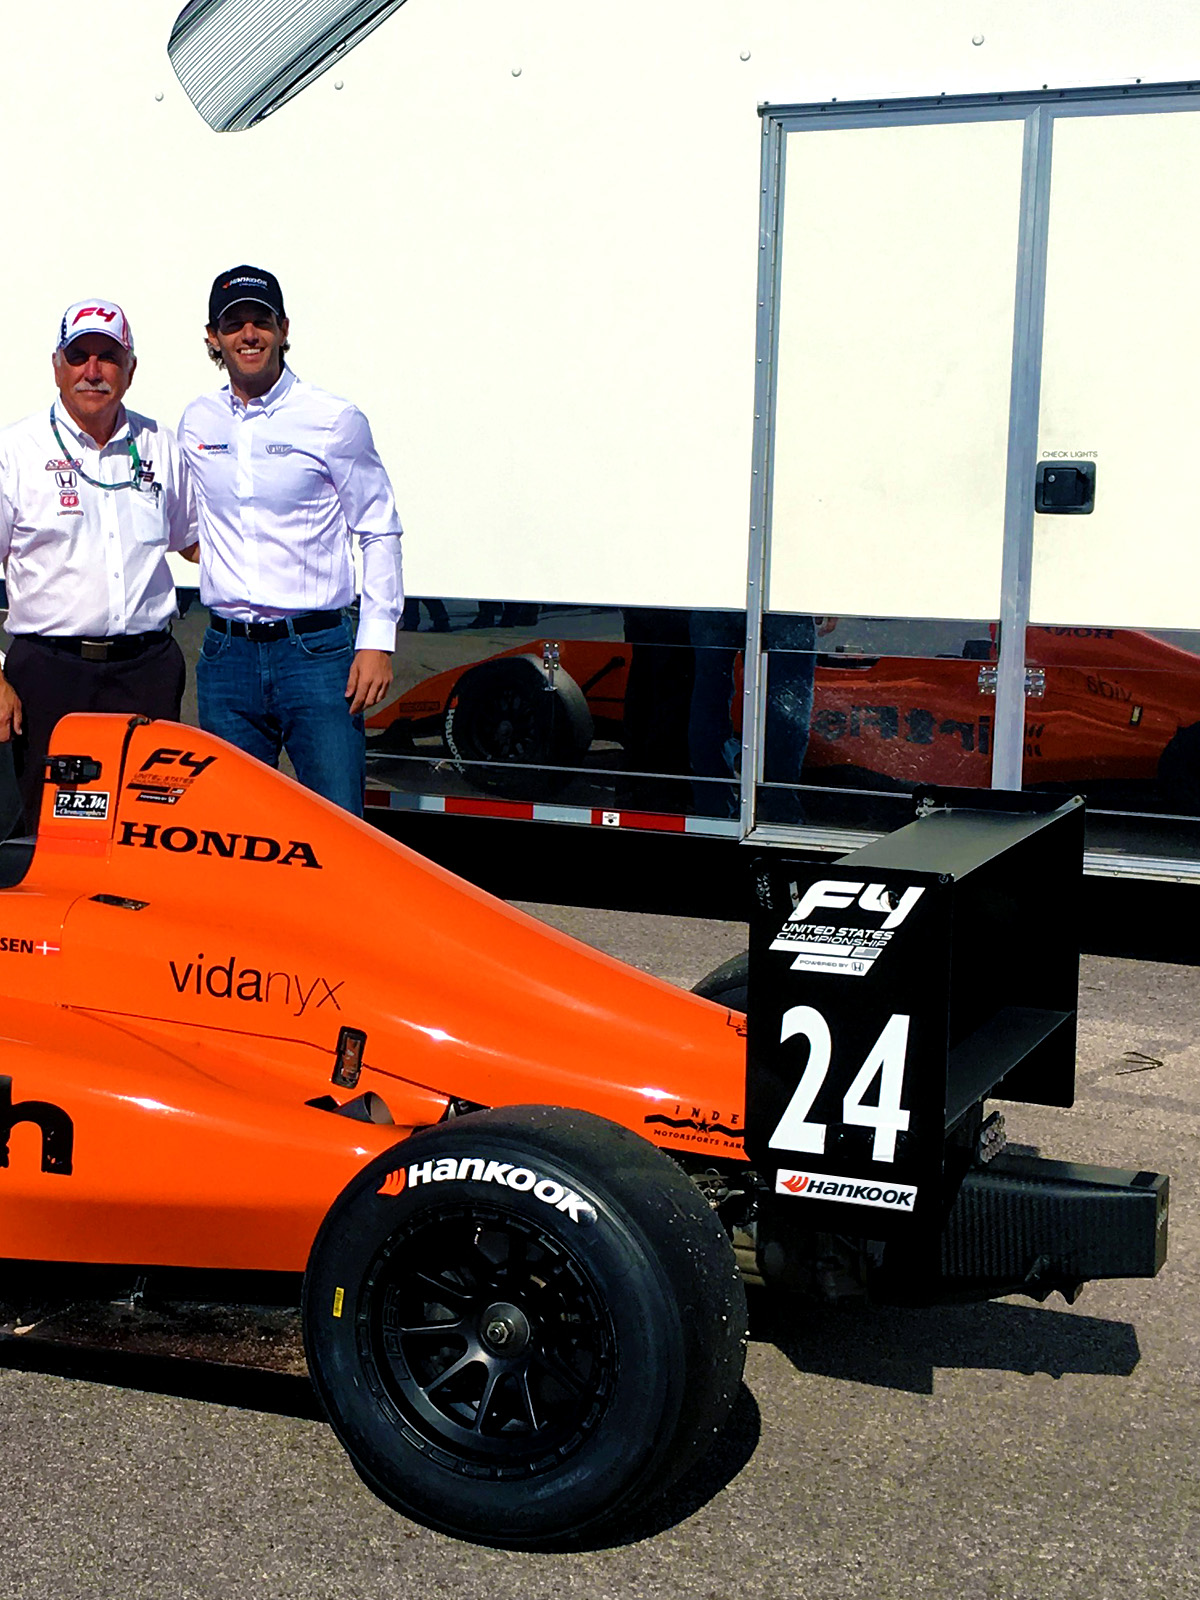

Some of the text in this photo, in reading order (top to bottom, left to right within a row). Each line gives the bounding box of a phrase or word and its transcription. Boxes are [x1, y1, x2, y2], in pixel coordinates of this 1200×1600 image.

[71, 306, 117, 326] F4
[1042, 450, 1099, 458] CHECK LIGHTS
[139, 747, 218, 778] F4
[116, 820, 323, 870] HONDA
[787, 879, 927, 930] F4
[776, 931, 888, 948] CHAMPIONSHIP
[781, 922, 895, 941] UNITED STATES
[799, 959, 837, 968] POWERED
[169, 953, 345, 1017] vidanyx
[767, 1004, 912, 1164] 24
[674, 1104, 740, 1125] INDE
[653, 1128, 720, 1146] MOTORSPORTS
